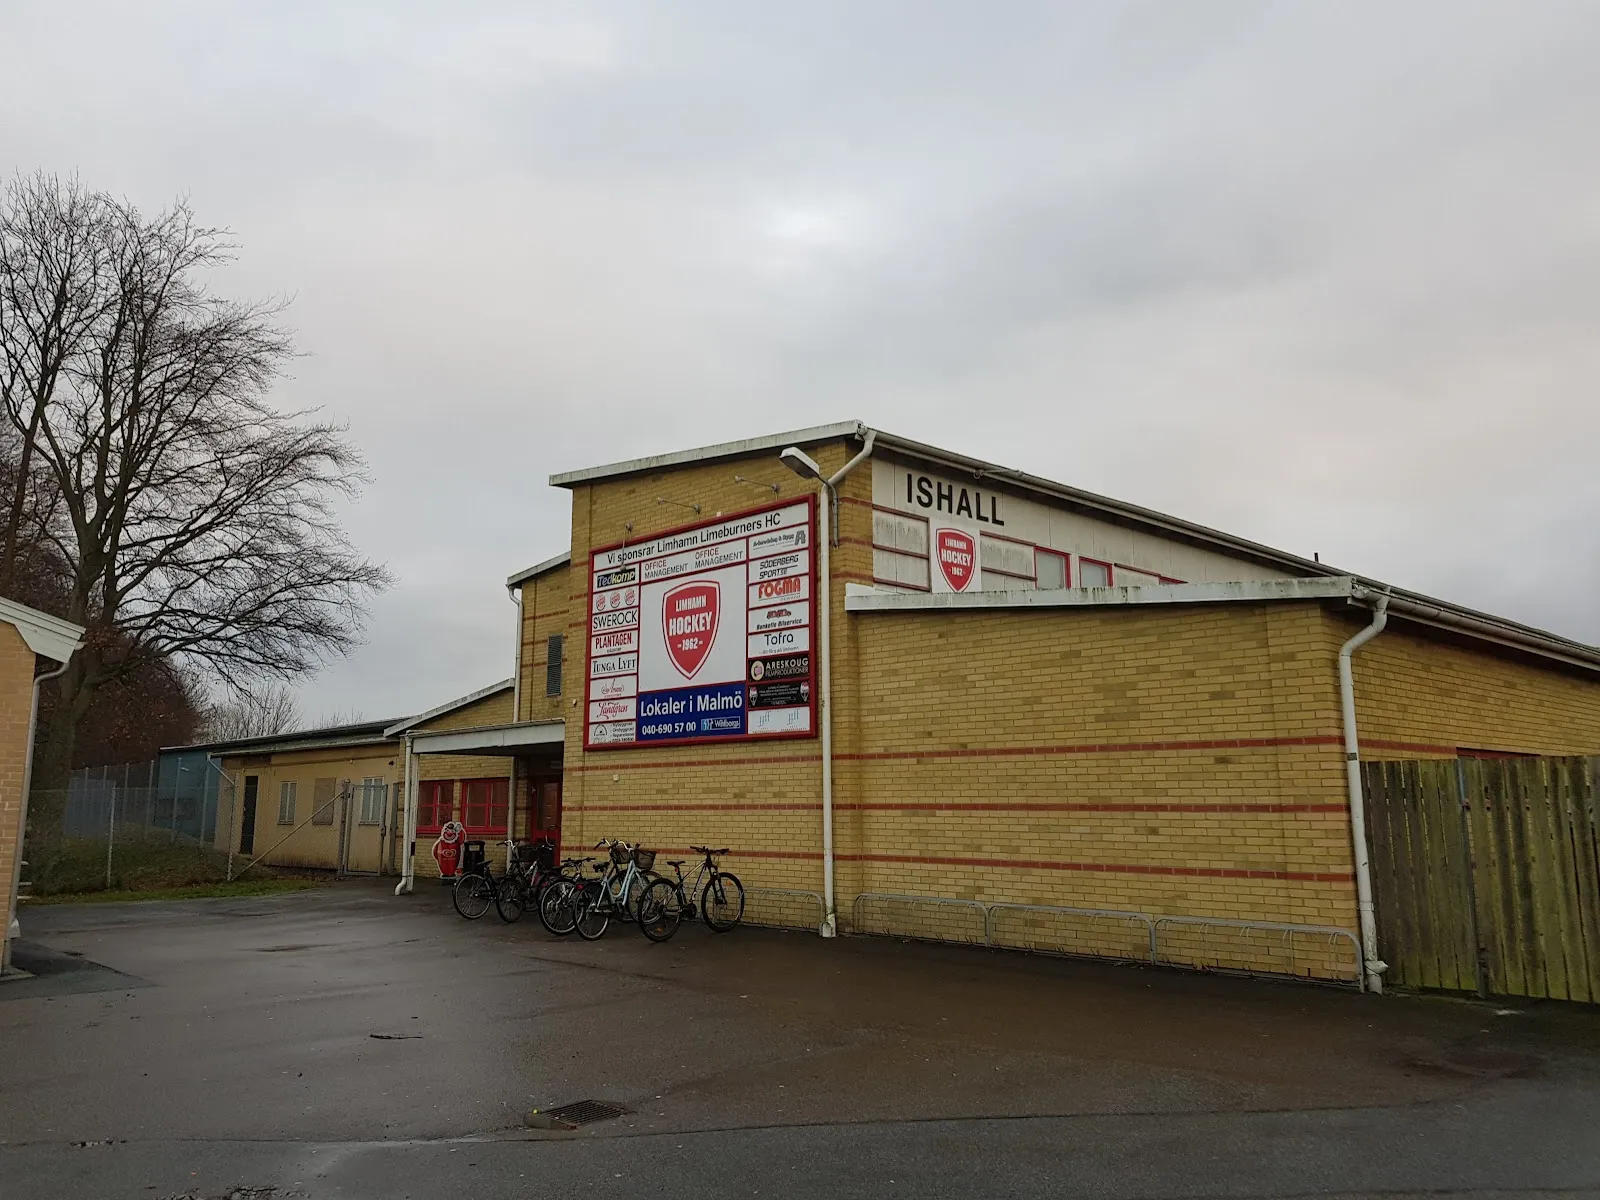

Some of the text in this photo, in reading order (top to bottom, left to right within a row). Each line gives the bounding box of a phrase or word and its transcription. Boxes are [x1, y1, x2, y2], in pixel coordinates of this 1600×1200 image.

[906, 472, 1005, 527] ISHALL
[607, 553, 616, 564] Vi
[657, 535, 698, 553] Limhamn
[700, 519, 762, 543] Limeburners
[765, 512, 781, 528] HC
[694, 551, 744, 569] MANAGEMENT
[695, 547, 719, 560] OFFICE
[759, 554, 799, 570] SÖDERBERG
[941, 548, 971, 567] HOCKEY
[644, 559, 667, 571] OFFICE
[644, 563, 689, 579] MANAGEMENT
[758, 577, 801, 598] FOGMA
[675, 594, 707, 612] LIMHAMN
[593, 610, 638, 629] SWEROCK
[669, 611, 713, 637] HOCKEY
[595, 632, 632, 649] PLANTAGEN
[764, 632, 794, 646] Tofra
[766, 657, 809, 670] ARESKOUG
[640, 697, 686, 717] Lokaler
[689, 695, 693, 713] i
[696, 691, 743, 712] Malmö
[642, 721, 697, 735] 040-690 57 00
